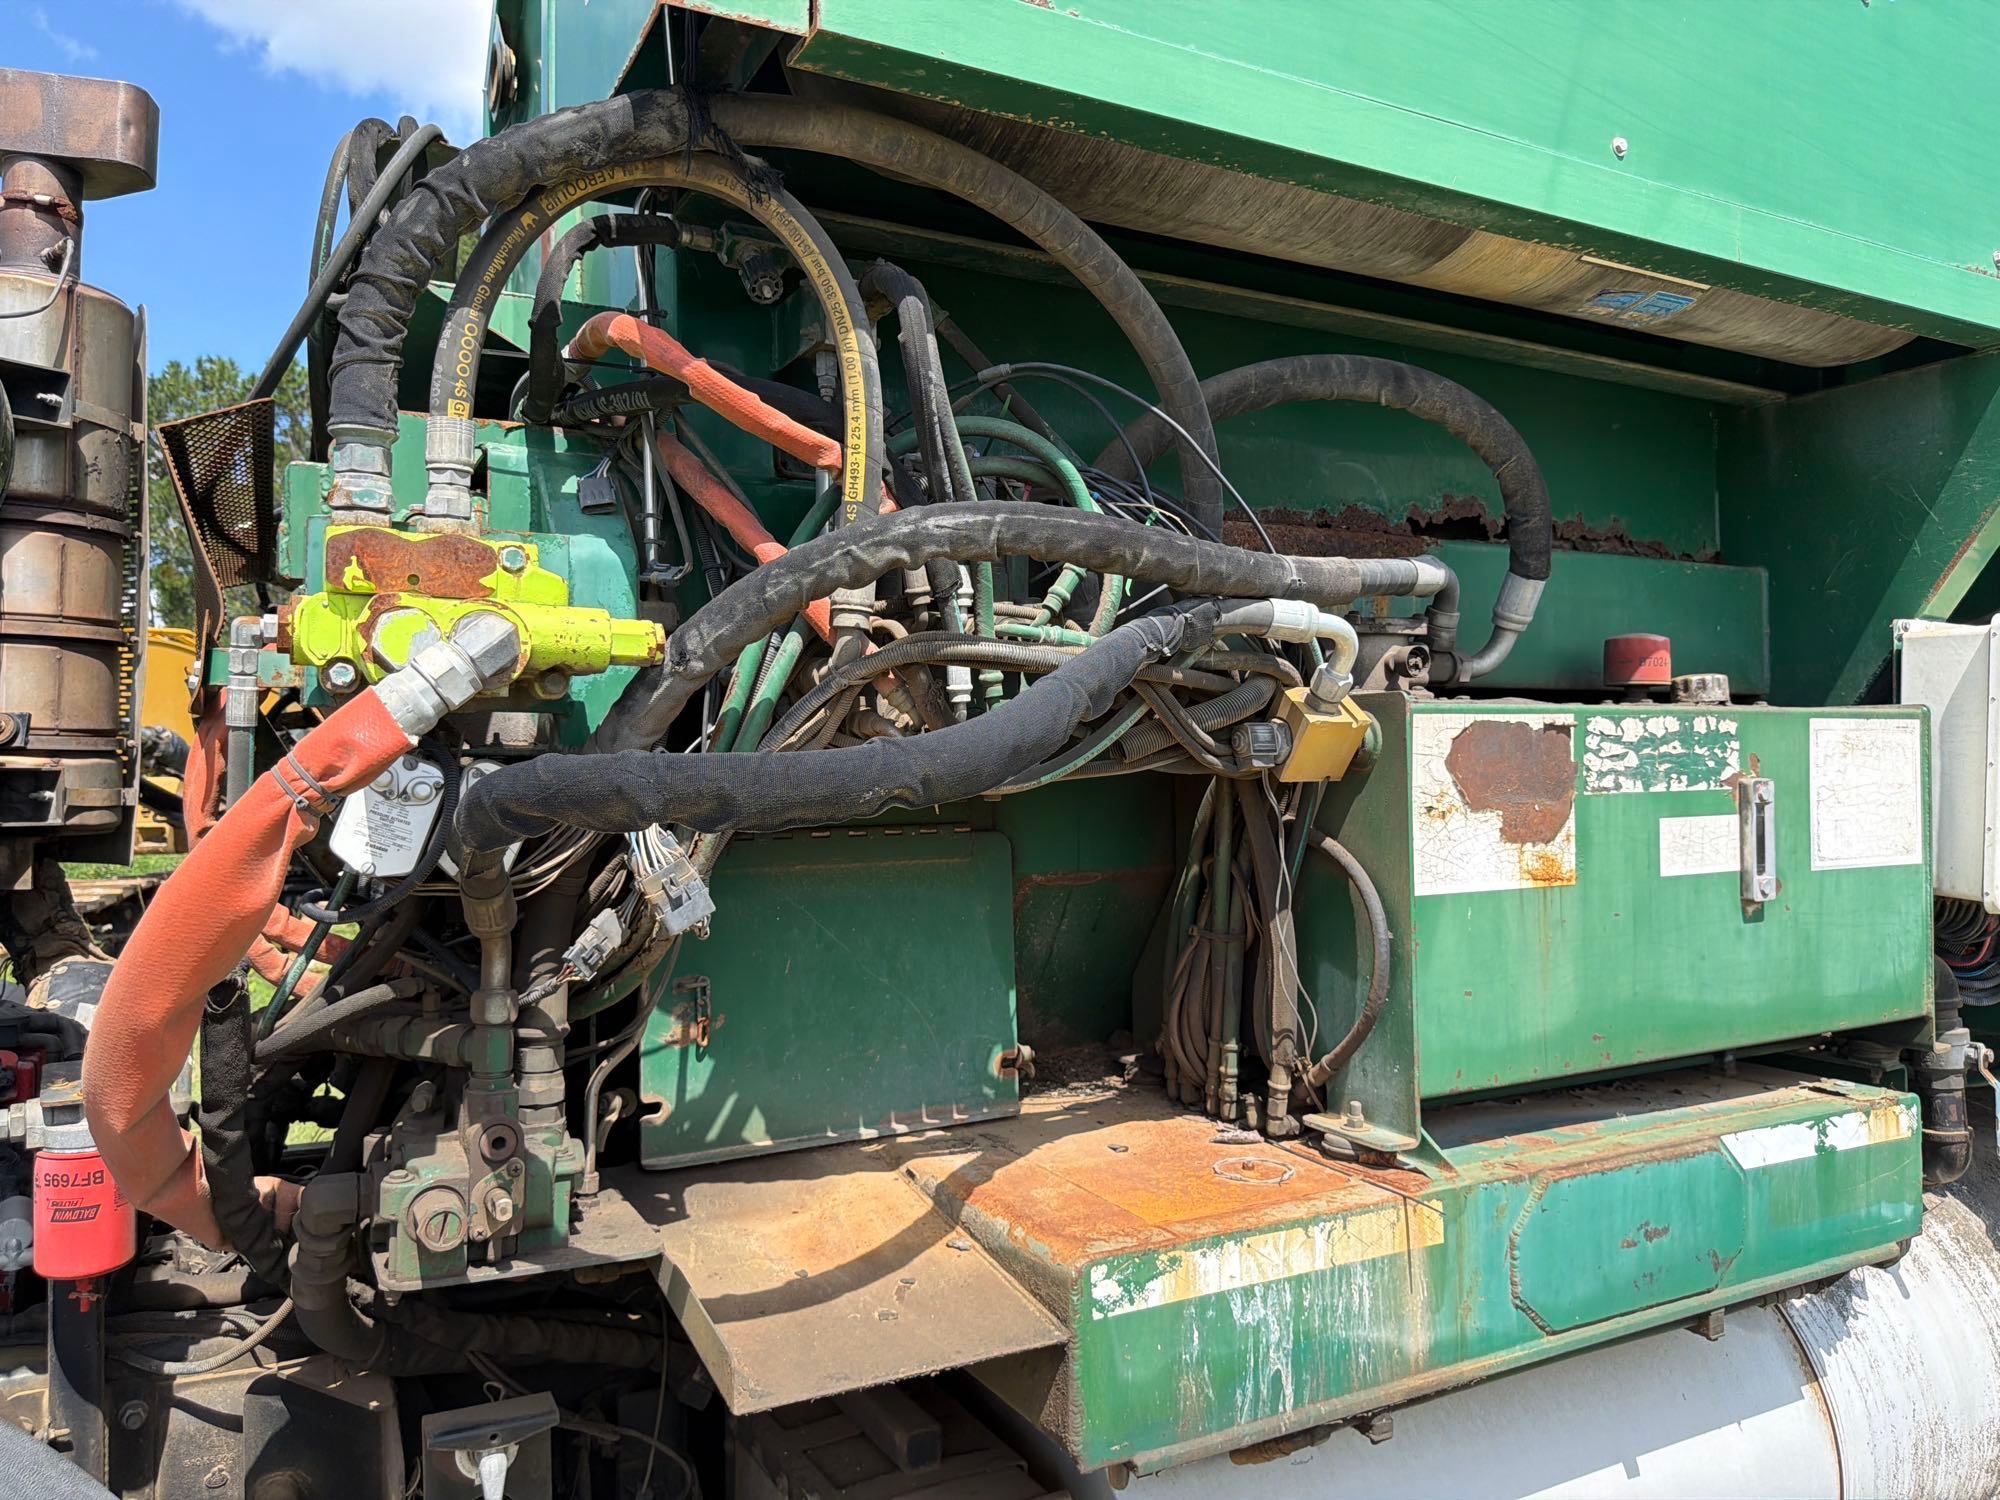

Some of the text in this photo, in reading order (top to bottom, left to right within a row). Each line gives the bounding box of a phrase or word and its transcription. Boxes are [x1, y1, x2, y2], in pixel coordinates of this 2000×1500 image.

[770, 207, 792, 228] psi)
[787, 226, 814, 258] (5100
[483, 226, 526, 284] MatchMate
[808, 256, 826, 277] bar
[819, 277, 837, 300] 350
[468, 284, 490, 321] Global
[829, 300, 849, 334] DN25
[840, 336, 853, 353] in)
[844, 356, 858, 384] (1.00
[850, 388, 861, 411] mm
[849, 415, 860, 439] 25.4
[847, 443, 860, 499] GH493-16
[844, 503, 858, 521] 4S
[44, 1170, 104, 1187] BF7695
[54, 1207, 97, 1221] BALDWIN
